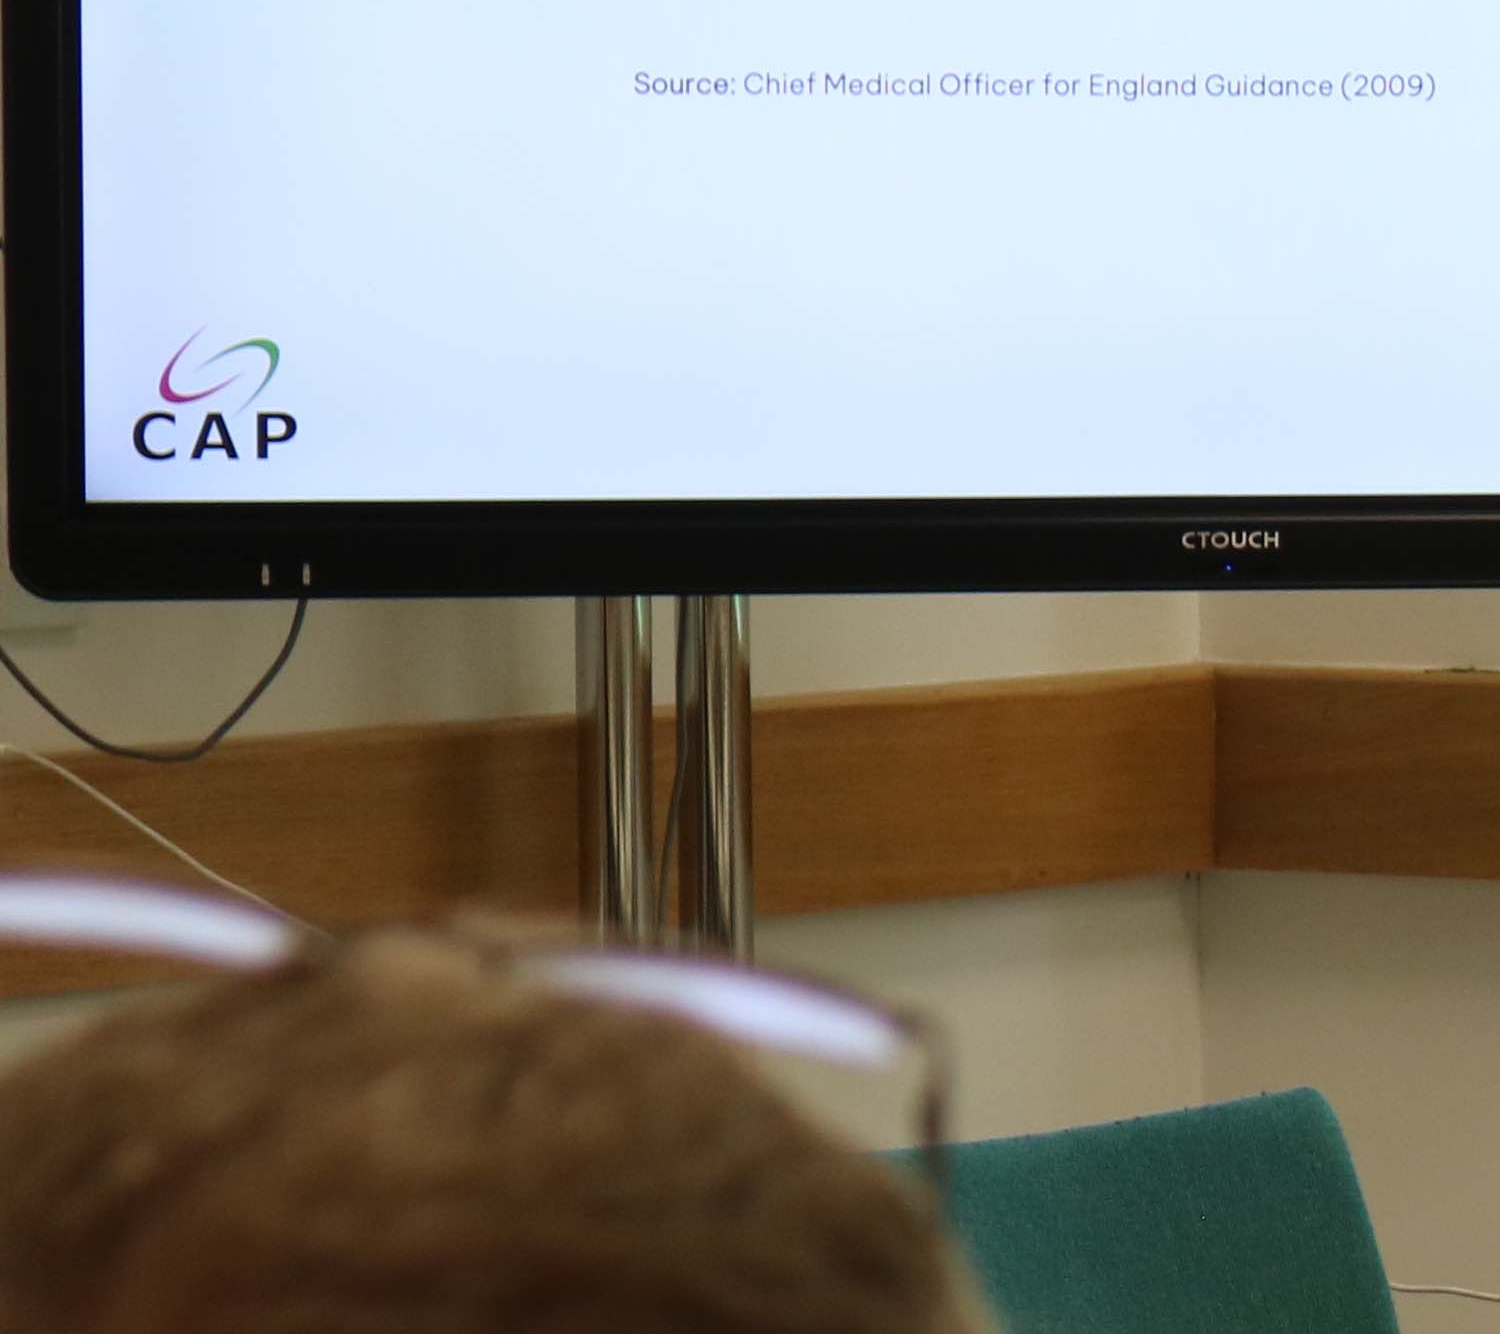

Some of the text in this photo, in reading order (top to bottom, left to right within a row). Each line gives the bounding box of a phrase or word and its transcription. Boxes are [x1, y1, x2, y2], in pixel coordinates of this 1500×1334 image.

[633, 70, 1437, 103] Source: Chief Medical Officer for England Guidance (2009)
[132, 411, 298, 462] CAP
[1181, 530, 1280, 549] CTOUCH
